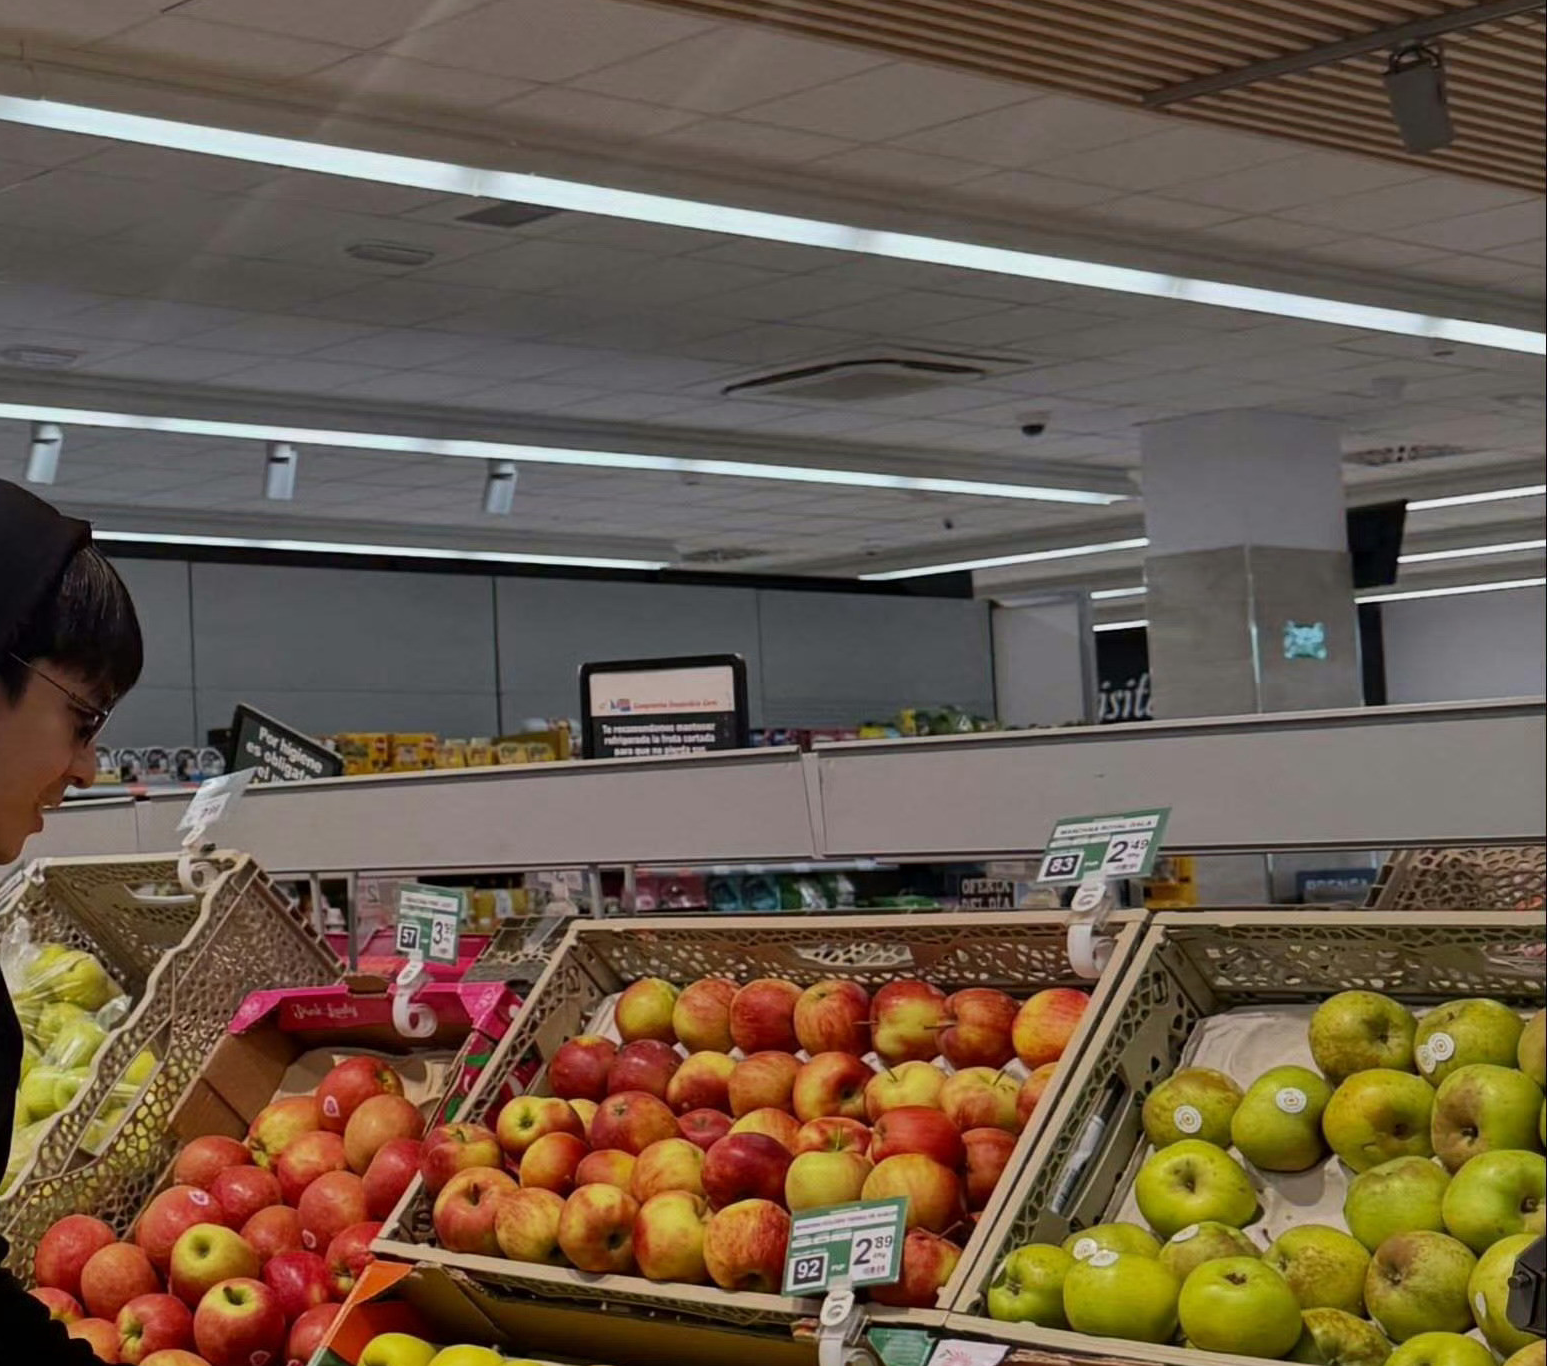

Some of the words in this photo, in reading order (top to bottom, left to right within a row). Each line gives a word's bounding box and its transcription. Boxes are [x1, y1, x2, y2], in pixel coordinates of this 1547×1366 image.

[1098, 672, 1152, 721] isit
[613, 724, 674, 734] recomendamos
[675, 722, 716, 732] mantener
[604, 735, 651, 746] refrigerada
[661, 734, 682, 744] fruta
[683, 733, 716, 743] cortada
[246, 741, 261, 757] es
[259, 726, 280, 748] Por
[280, 737, 323, 774] higiene
[1049, 857, 1075, 873] 83
[402, 928, 416, 944] 57
[327, 1002, 359, 1019] Lady
[797, 1258, 821, 1279] 92
